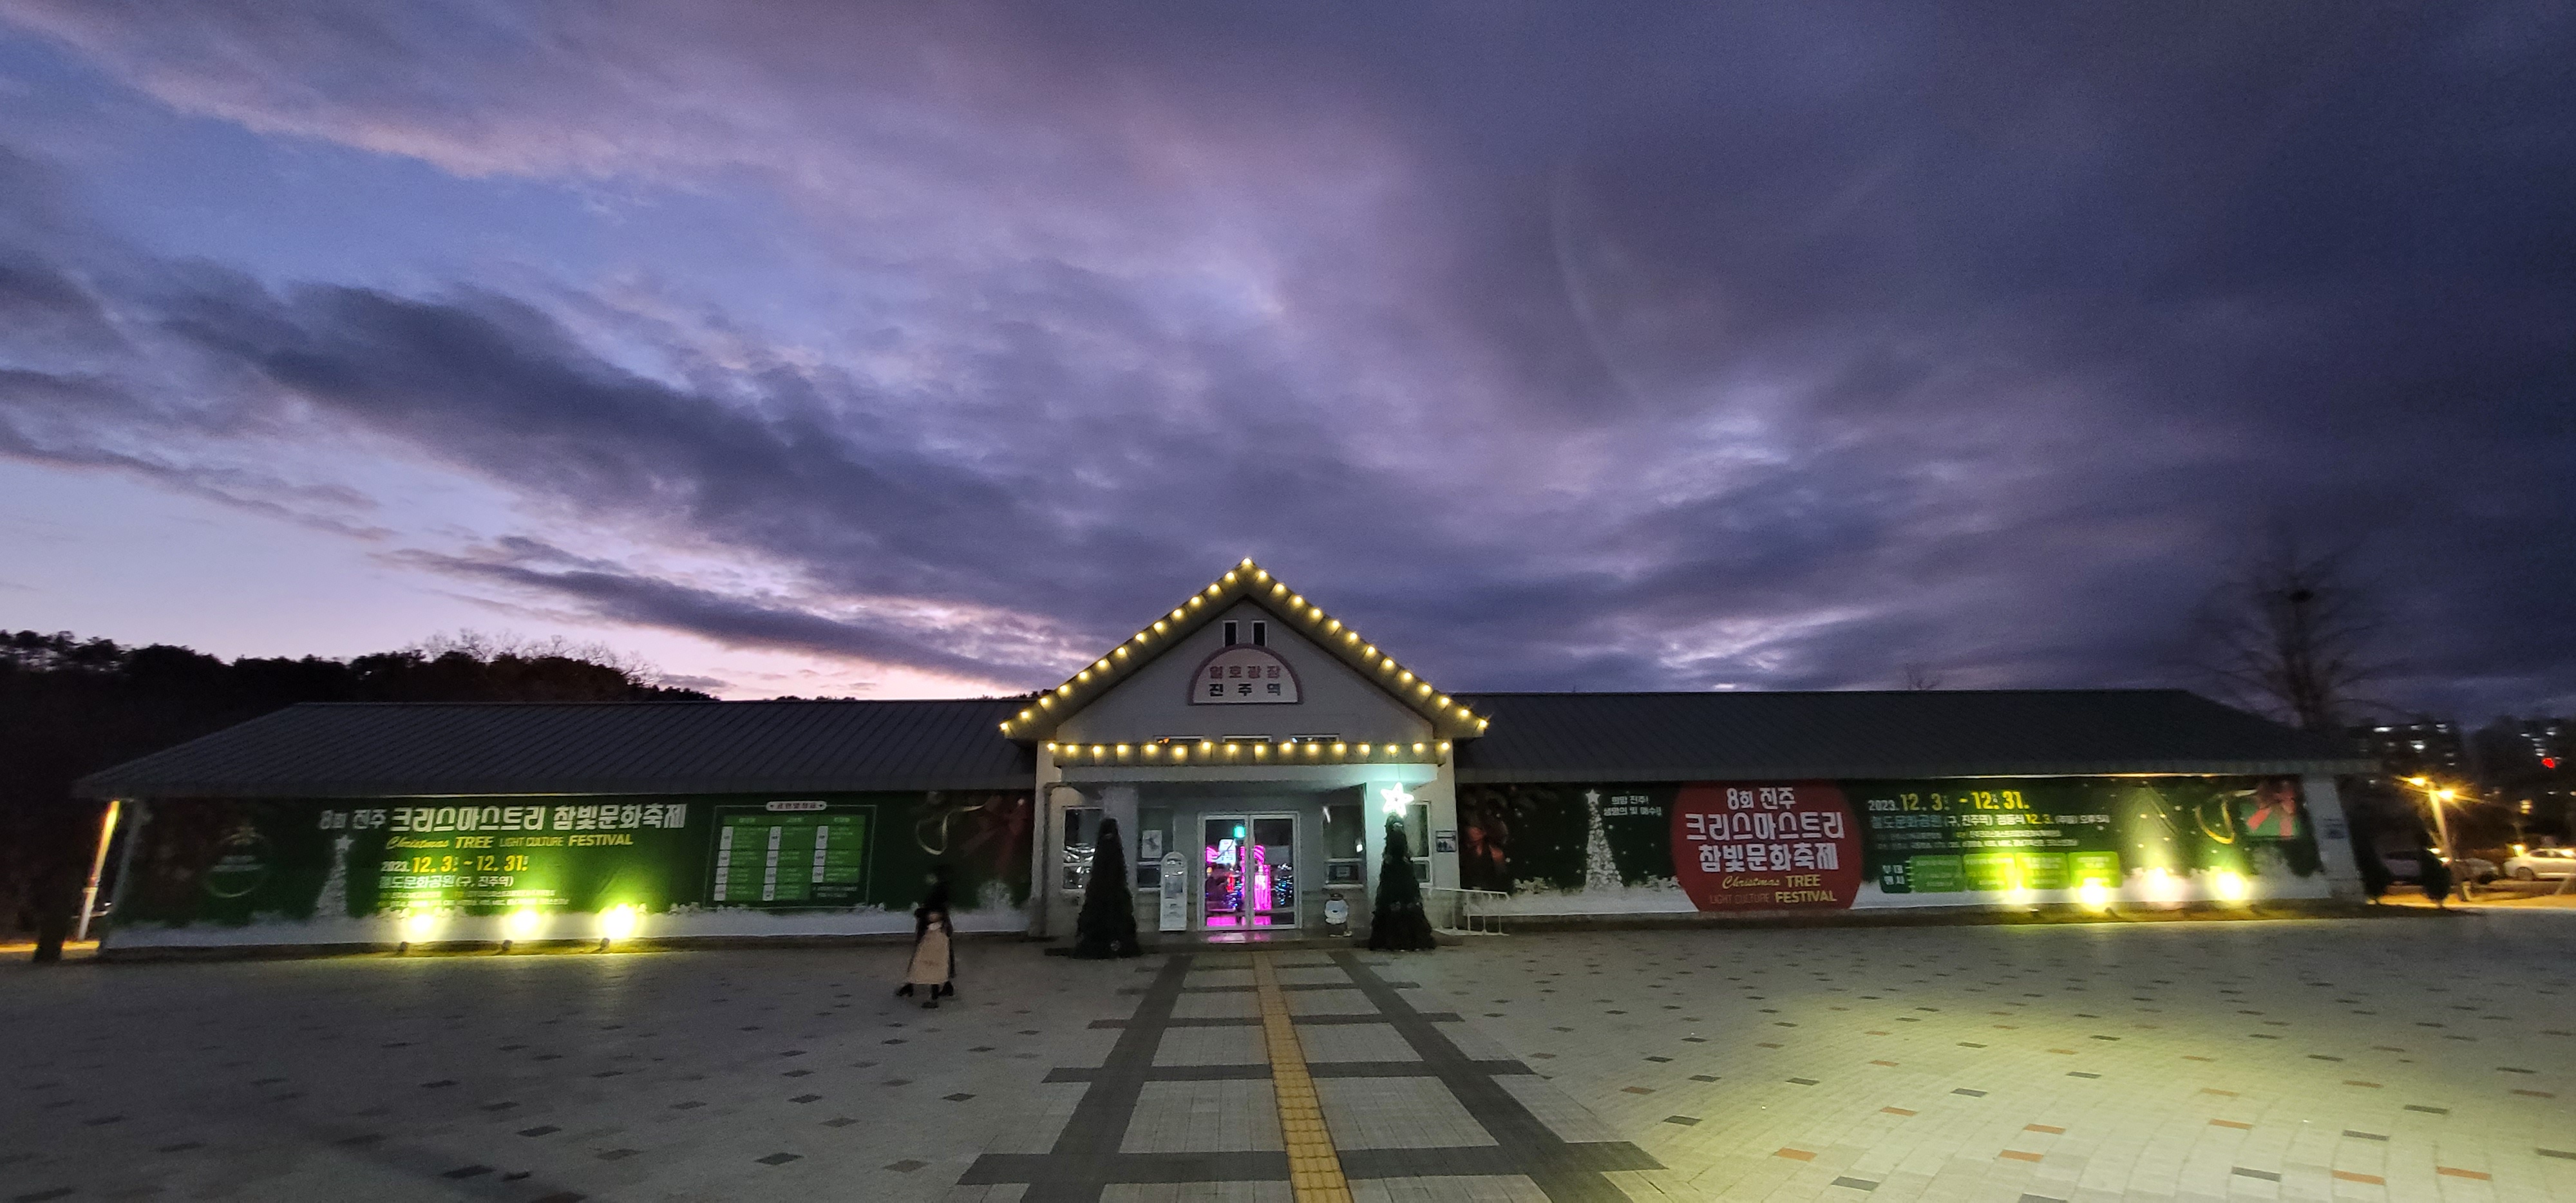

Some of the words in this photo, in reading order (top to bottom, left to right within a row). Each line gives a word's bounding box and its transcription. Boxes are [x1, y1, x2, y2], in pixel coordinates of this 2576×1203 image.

[1727, 788, 1754, 810] 8회
[1759, 787, 1795, 809] 진주
[353, 809, 386, 829] 진주
[390, 806, 546, 833] 크리스마스트리
[553, 803, 687, 831] 참빛문화축제
[1685, 811, 1845, 840] 크리스마스트리
[385, 837, 450, 849] Christmas
[455, 836, 495, 848] TREE
[568, 833, 634, 846] FESTIVAL
[1698, 842, 1839, 873] 참빛문화축제
[1722, 875, 1780, 889] Christmas
[1785, 874, 1821, 887] TREE
[1775, 890, 1837, 904] FESTIVAL
